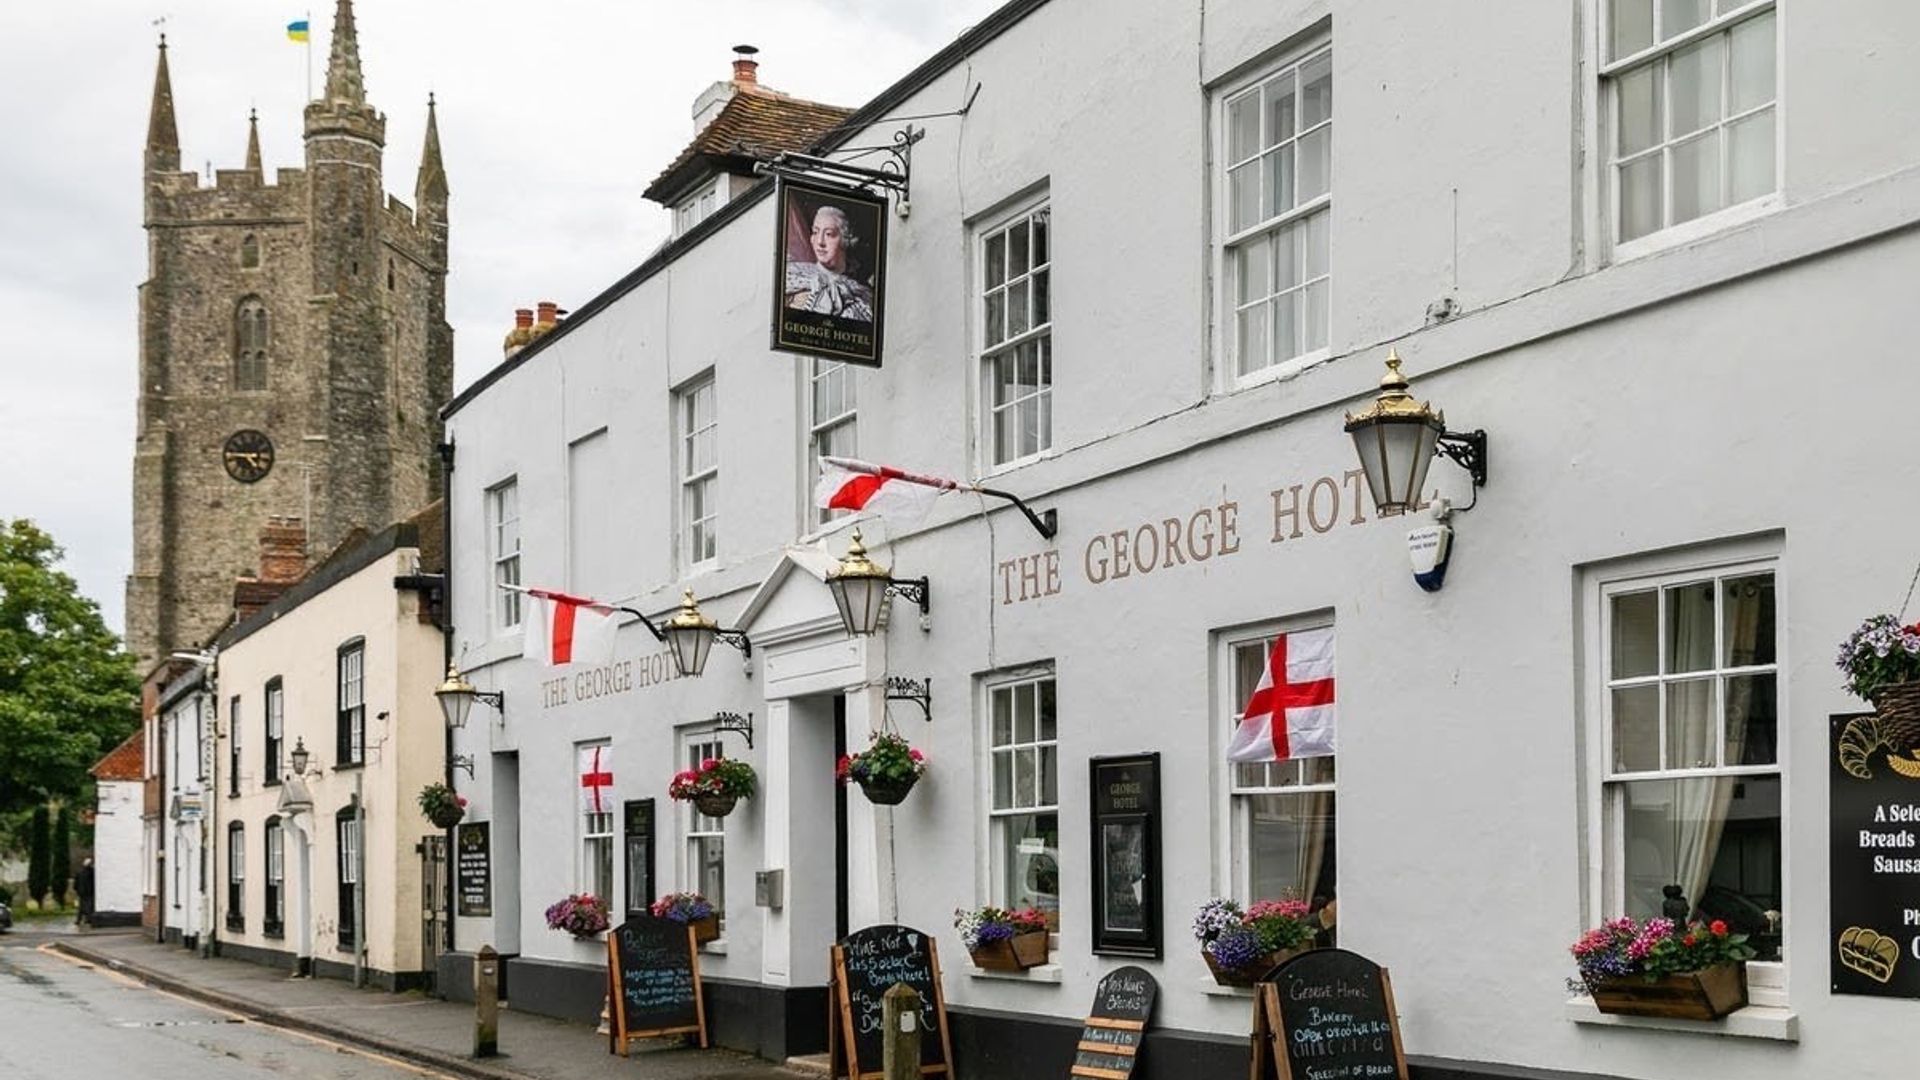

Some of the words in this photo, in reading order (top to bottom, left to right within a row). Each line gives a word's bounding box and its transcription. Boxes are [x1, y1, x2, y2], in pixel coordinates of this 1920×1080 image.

[784, 322, 831, 338] GEORGE
[833, 330, 871, 346] HOTEL
[999, 549, 1062, 605] THE
[1084, 501, 1240, 585] GEORGE
[1270, 467, 1439, 543] HOT
[541, 677, 568, 709] THE
[574, 661, 633, 702] GEORGE
[1874, 804, 1887, 822] A
[1889, 804, 1920, 823] Sele
[1859, 829, 1915, 847] Breads
[1873, 855, 1920, 873] Sausa
